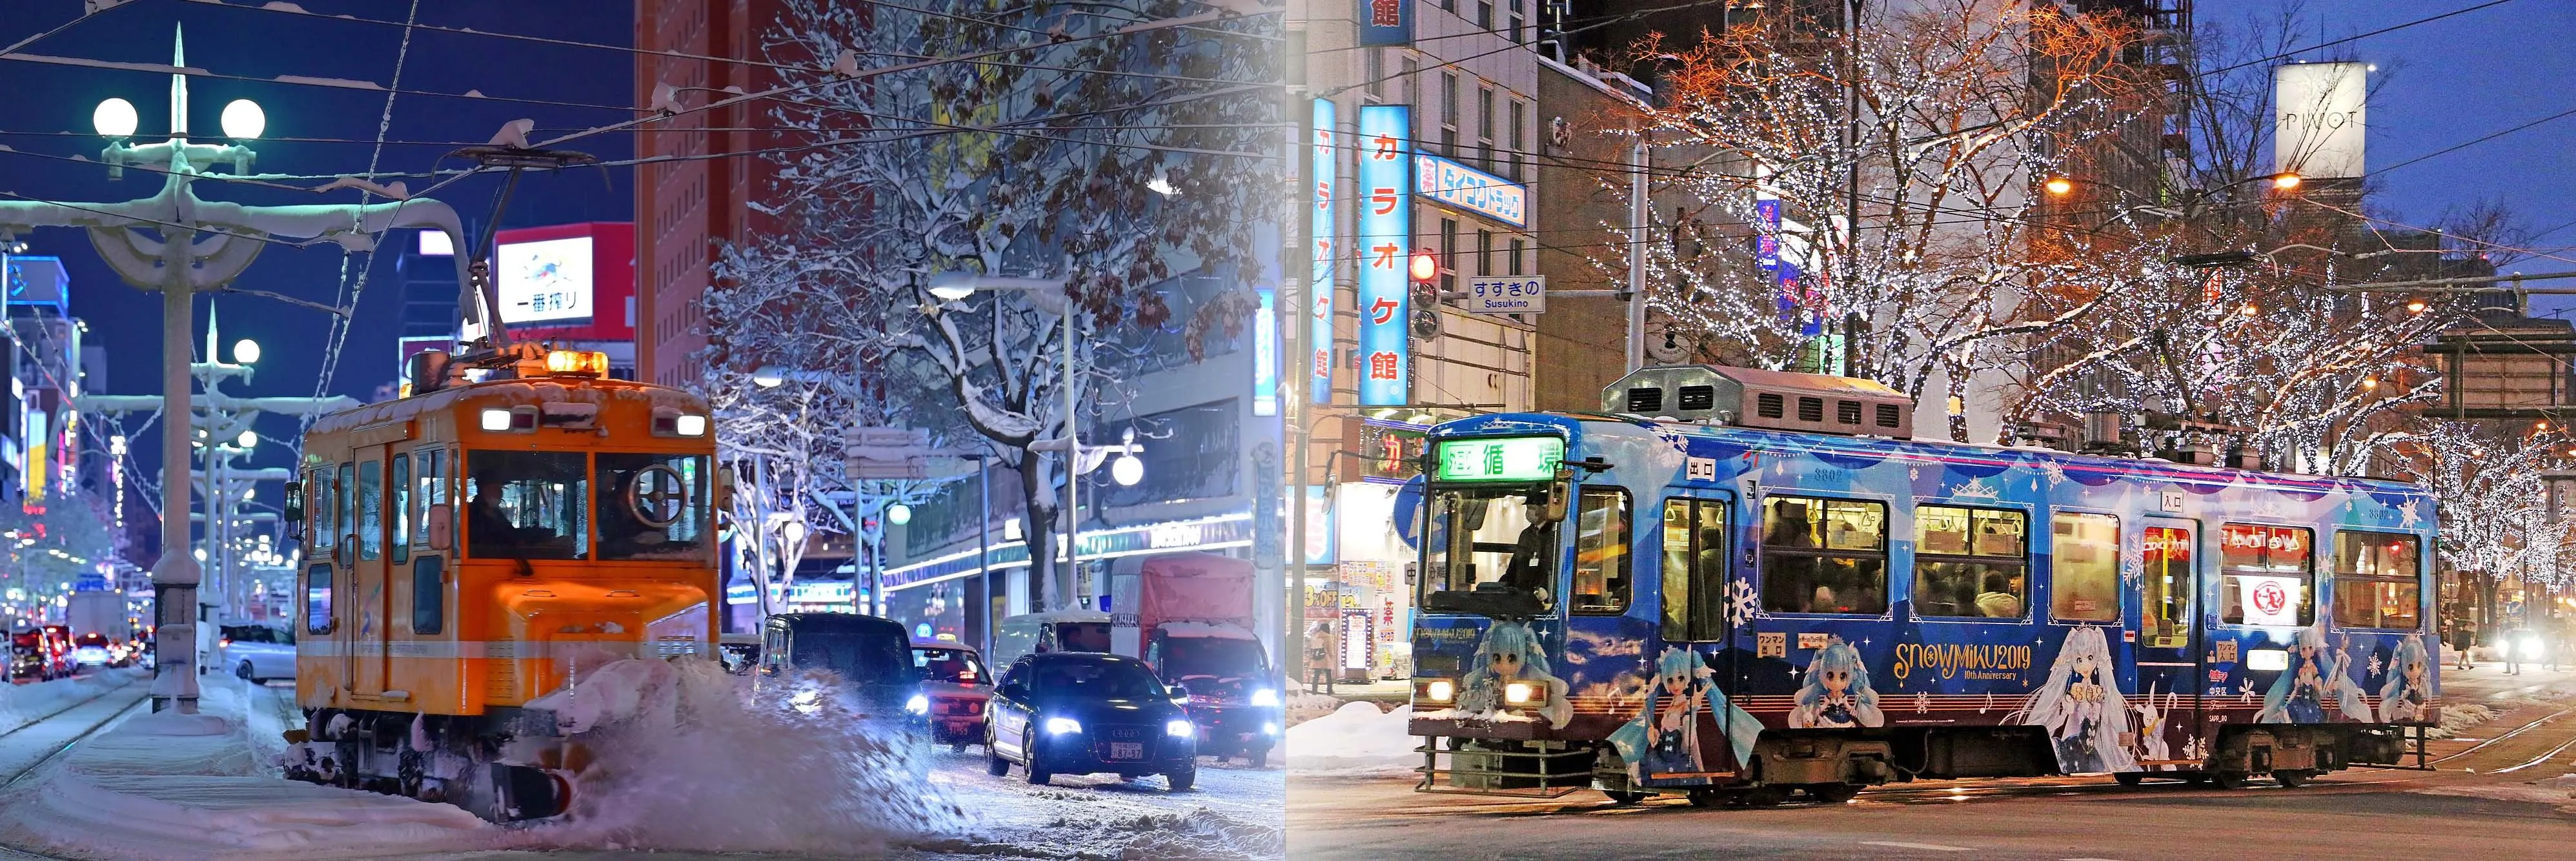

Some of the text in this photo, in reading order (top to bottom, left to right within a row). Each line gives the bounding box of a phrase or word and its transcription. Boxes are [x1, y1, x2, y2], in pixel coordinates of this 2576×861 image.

[2287, 111, 2357, 130] PIVOT
[1315, 128, 1330, 378] カラオケ館
[1370, 134, 1399, 380] カラオケ館
[1474, 281, 1539, 297] すすきの
[517, 291, 576, 311] 一番搾り
[1485, 299, 1528, 308] Susukino
[1483, 443, 1559, 476] 循環
[1690, 461, 1712, 475] 出口
[2164, 495, 2181, 507] 入口
[1762, 645, 1782, 654] 出口
[1965, 670, 2016, 680] 10th Anniversary
[2209, 687, 2227, 696] 中央区
